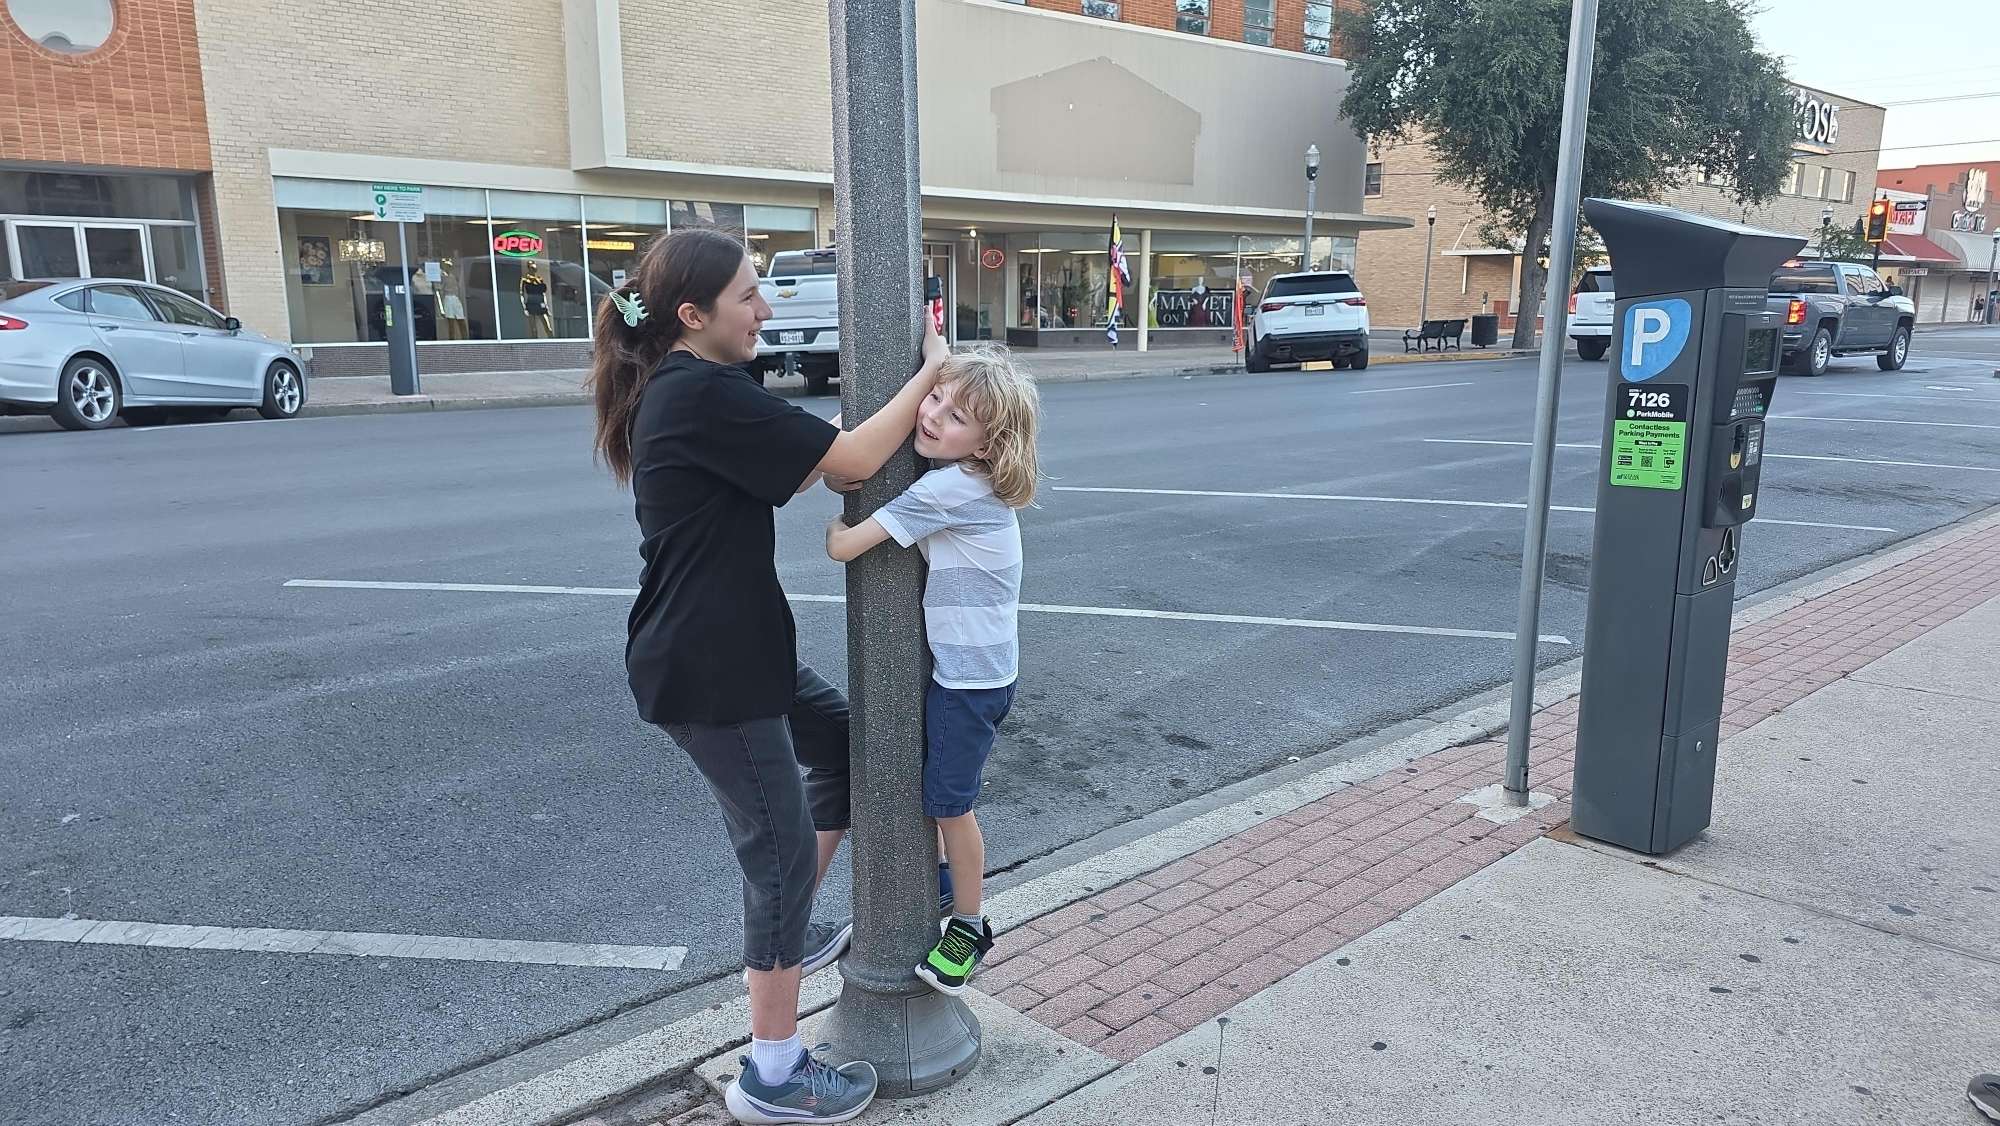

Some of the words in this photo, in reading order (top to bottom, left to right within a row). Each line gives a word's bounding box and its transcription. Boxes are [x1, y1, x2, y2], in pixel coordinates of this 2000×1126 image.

[494, 236, 543, 252] OPEN
[1160, 295, 1231, 311] MAET
[1163, 313, 1180, 323] ON
[1183, 311, 1226, 325] MIN
[1631, 308, 1671, 366] P
[1628, 392, 1670, 407] 7126
[1636, 410, 1674, 418] ParkMobile
[1629, 423, 1670, 431] Contactless
[1618, 430, 1645, 438] Parking
[1645, 431, 1680, 439] Payments
